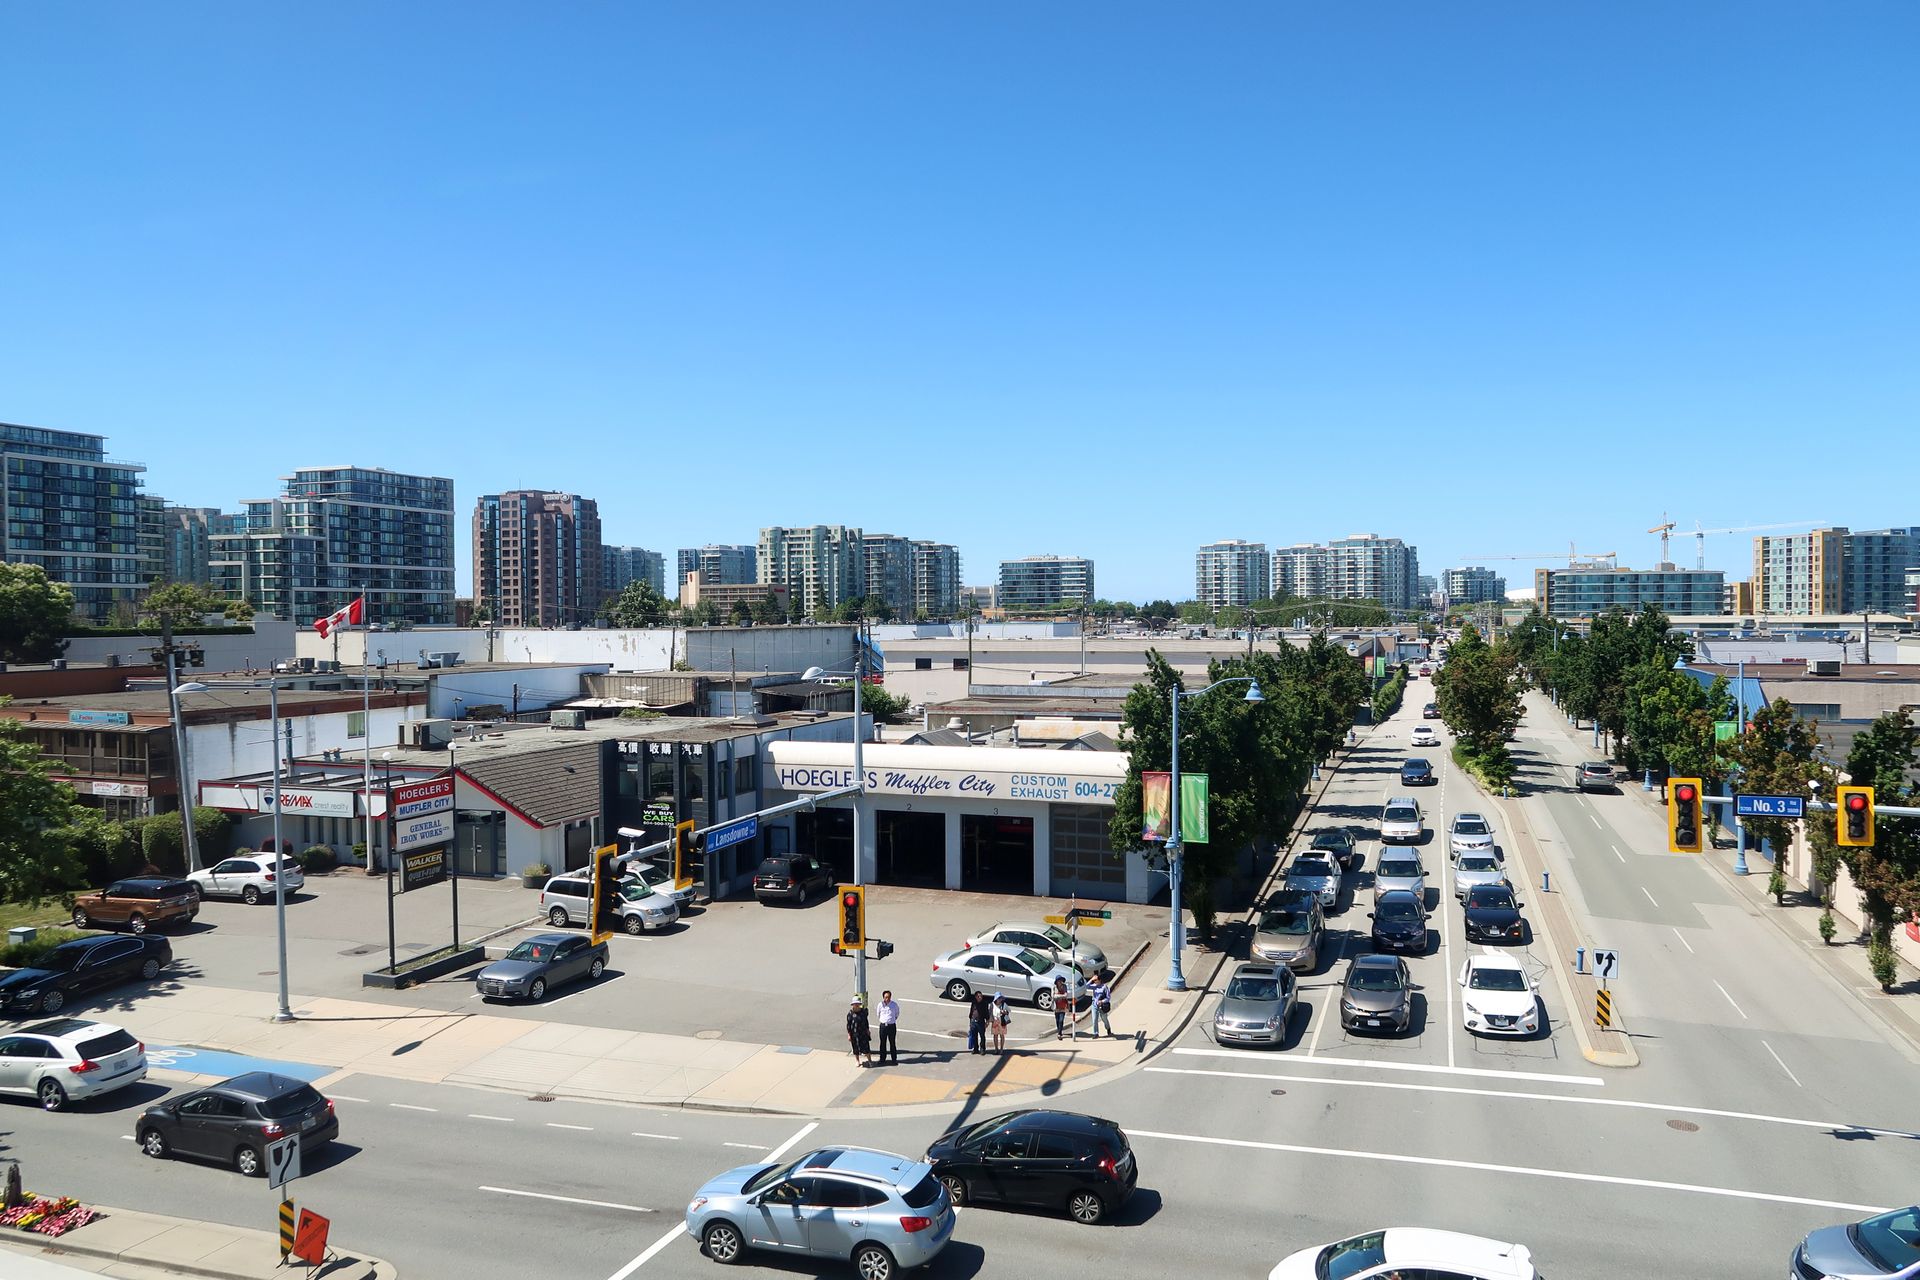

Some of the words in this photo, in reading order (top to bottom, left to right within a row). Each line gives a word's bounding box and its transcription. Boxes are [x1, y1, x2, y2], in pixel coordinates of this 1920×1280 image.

[618, 741, 638, 754] 高價
[649, 742, 671, 755] 收購
[681, 743, 703, 756] 汽車
[781, 769, 878, 789] HOEGLE'S
[885, 772, 951, 795] Muffler
[958, 775, 996, 797] City
[1011, 775, 1067, 787] CUSTOM
[399, 783, 450, 801] HOEGLER'S
[1010, 787, 1069, 799] EXHAUST
[1075, 782, 1121, 798] 604-27
[280, 794, 313, 808] RE/MAX
[400, 801, 432, 816] MUFFLER
[434, 797, 450, 809] CITY
[1753, 799, 1774, 813] No.
[1777, 800, 1786, 813] 3
[643, 815, 675, 823] CARS
[410, 820, 442, 833] GENERAL
[401, 834, 418, 845] IRON
[420, 828, 443, 842] WORKS
[715, 826, 749, 847] Lansdowne
[407, 853, 443, 869] WALKER
